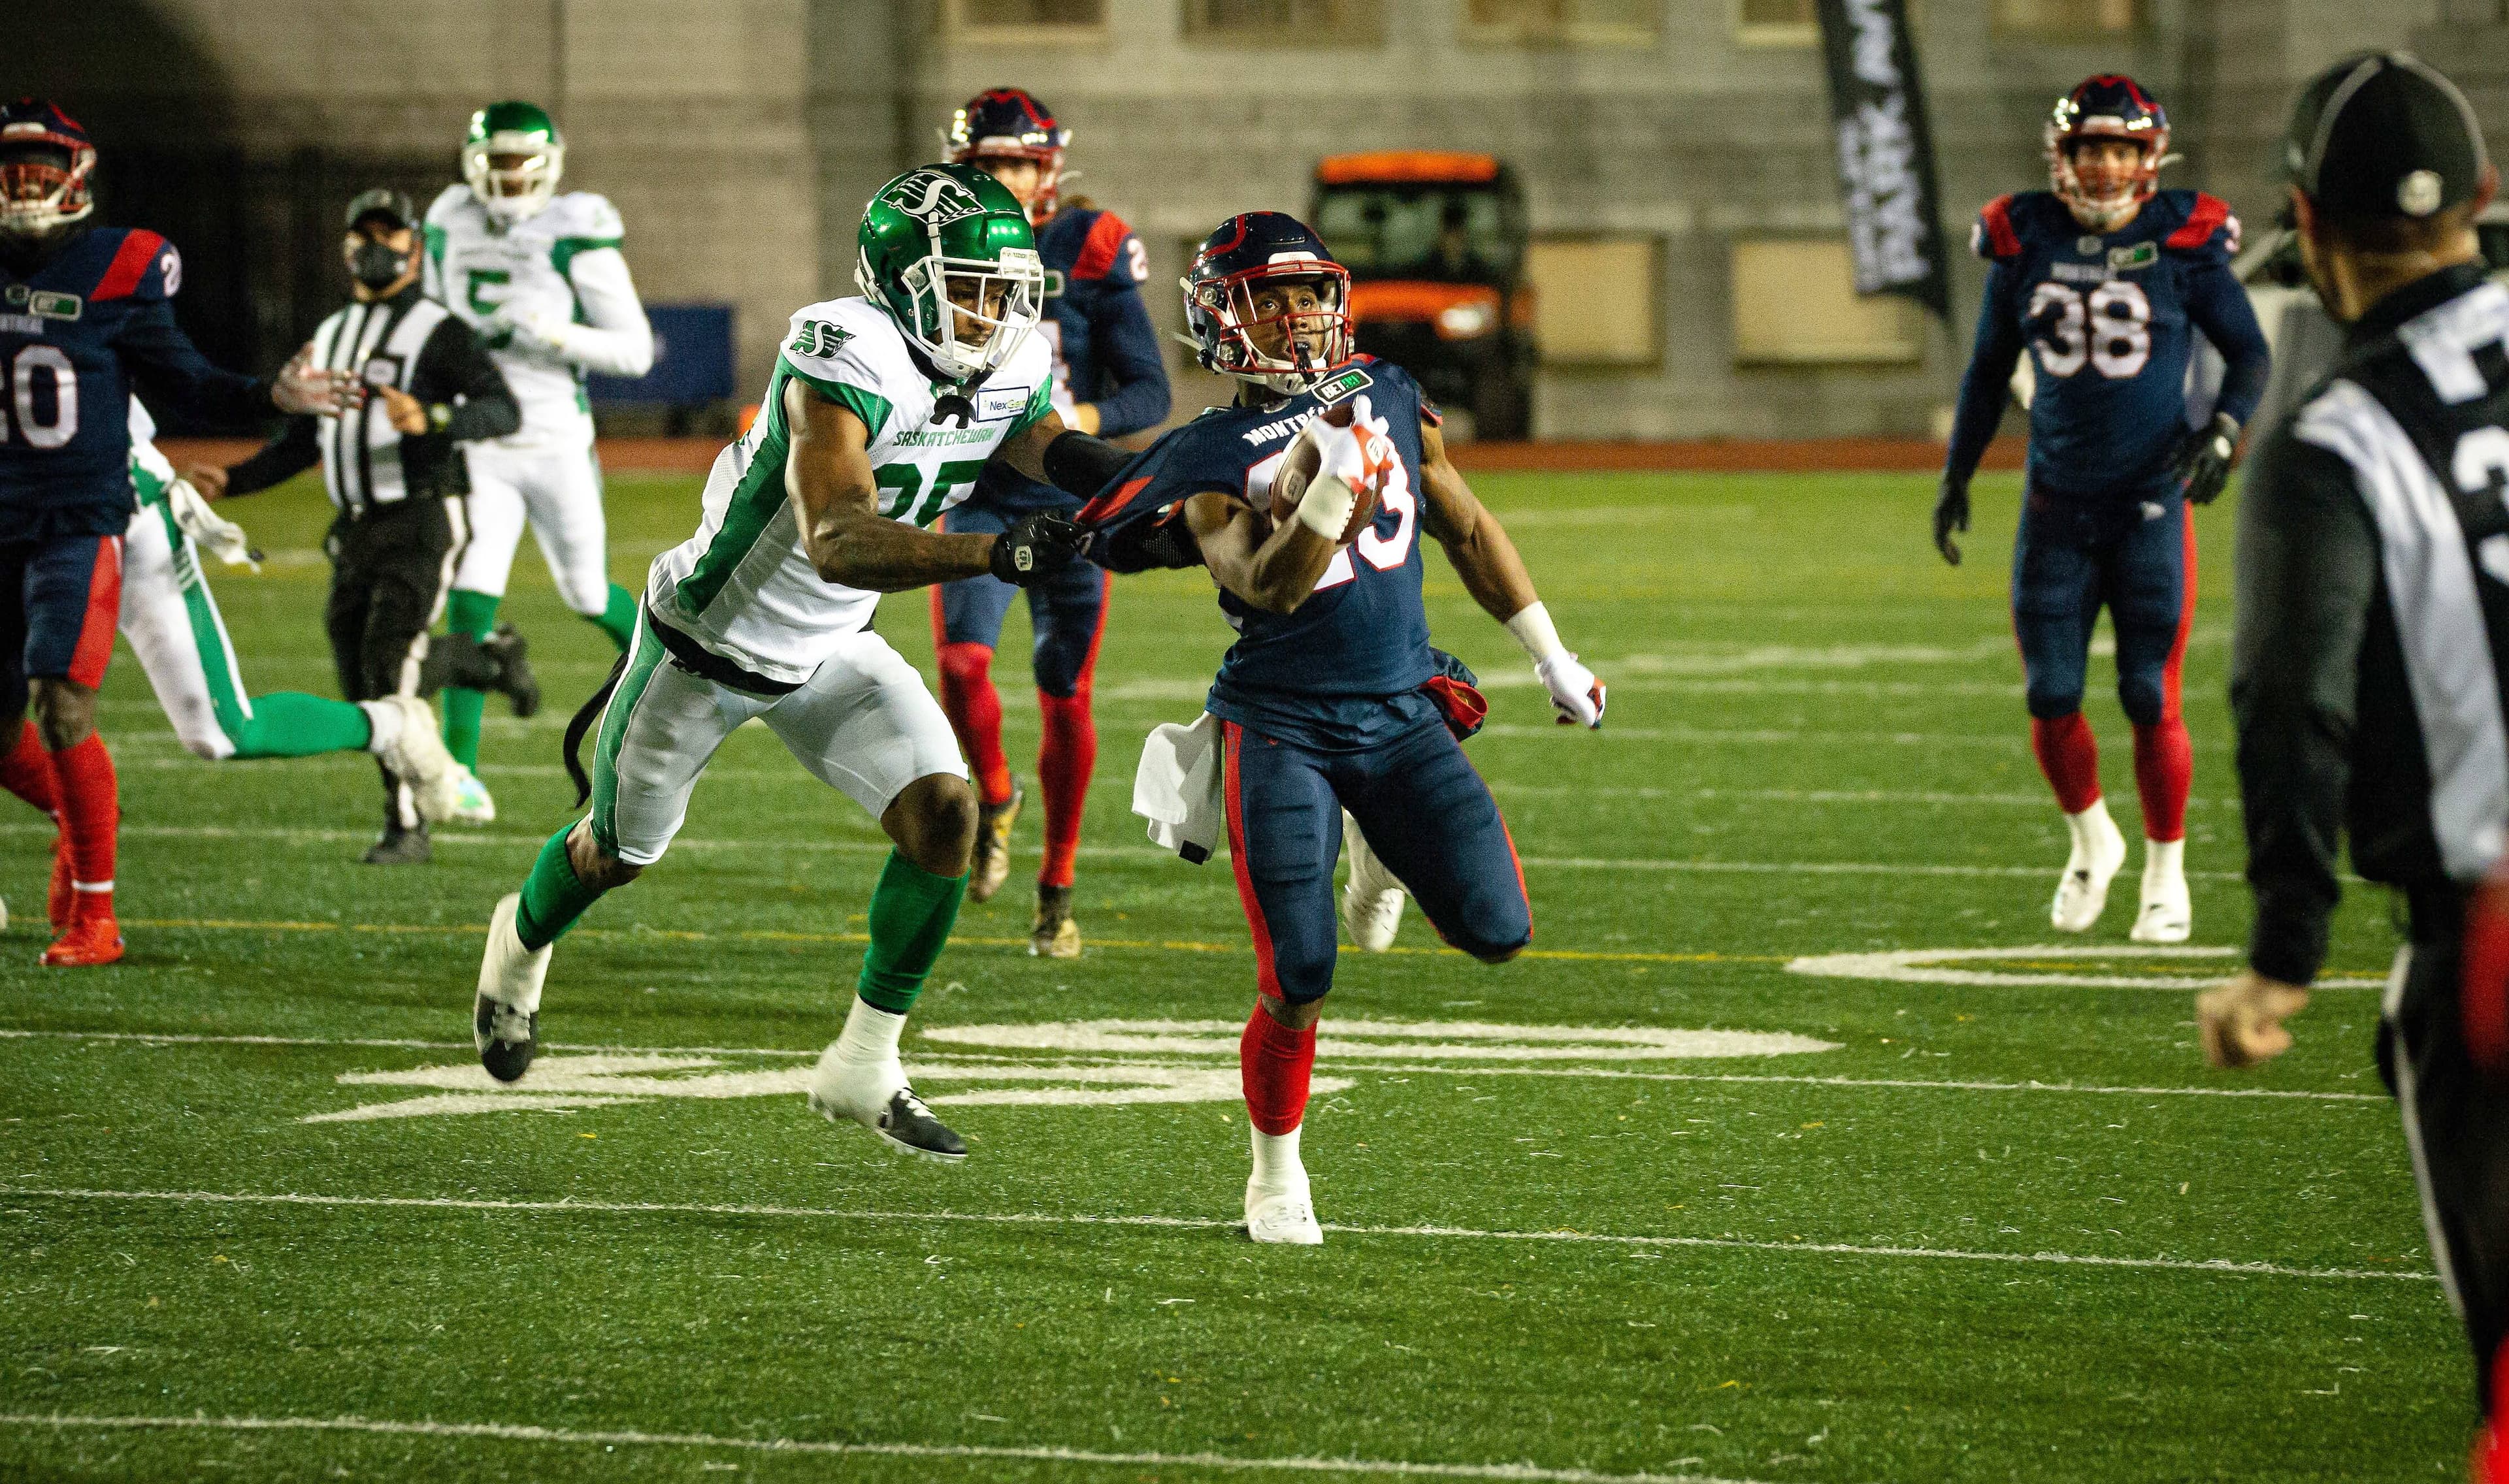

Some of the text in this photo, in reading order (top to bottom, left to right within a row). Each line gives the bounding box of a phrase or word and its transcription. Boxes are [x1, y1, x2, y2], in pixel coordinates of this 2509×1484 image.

[2029, 280, 2152, 379] 38
[0, 344, 78, 449] 0
[893, 428, 996, 447] SASKATCHEWAN
